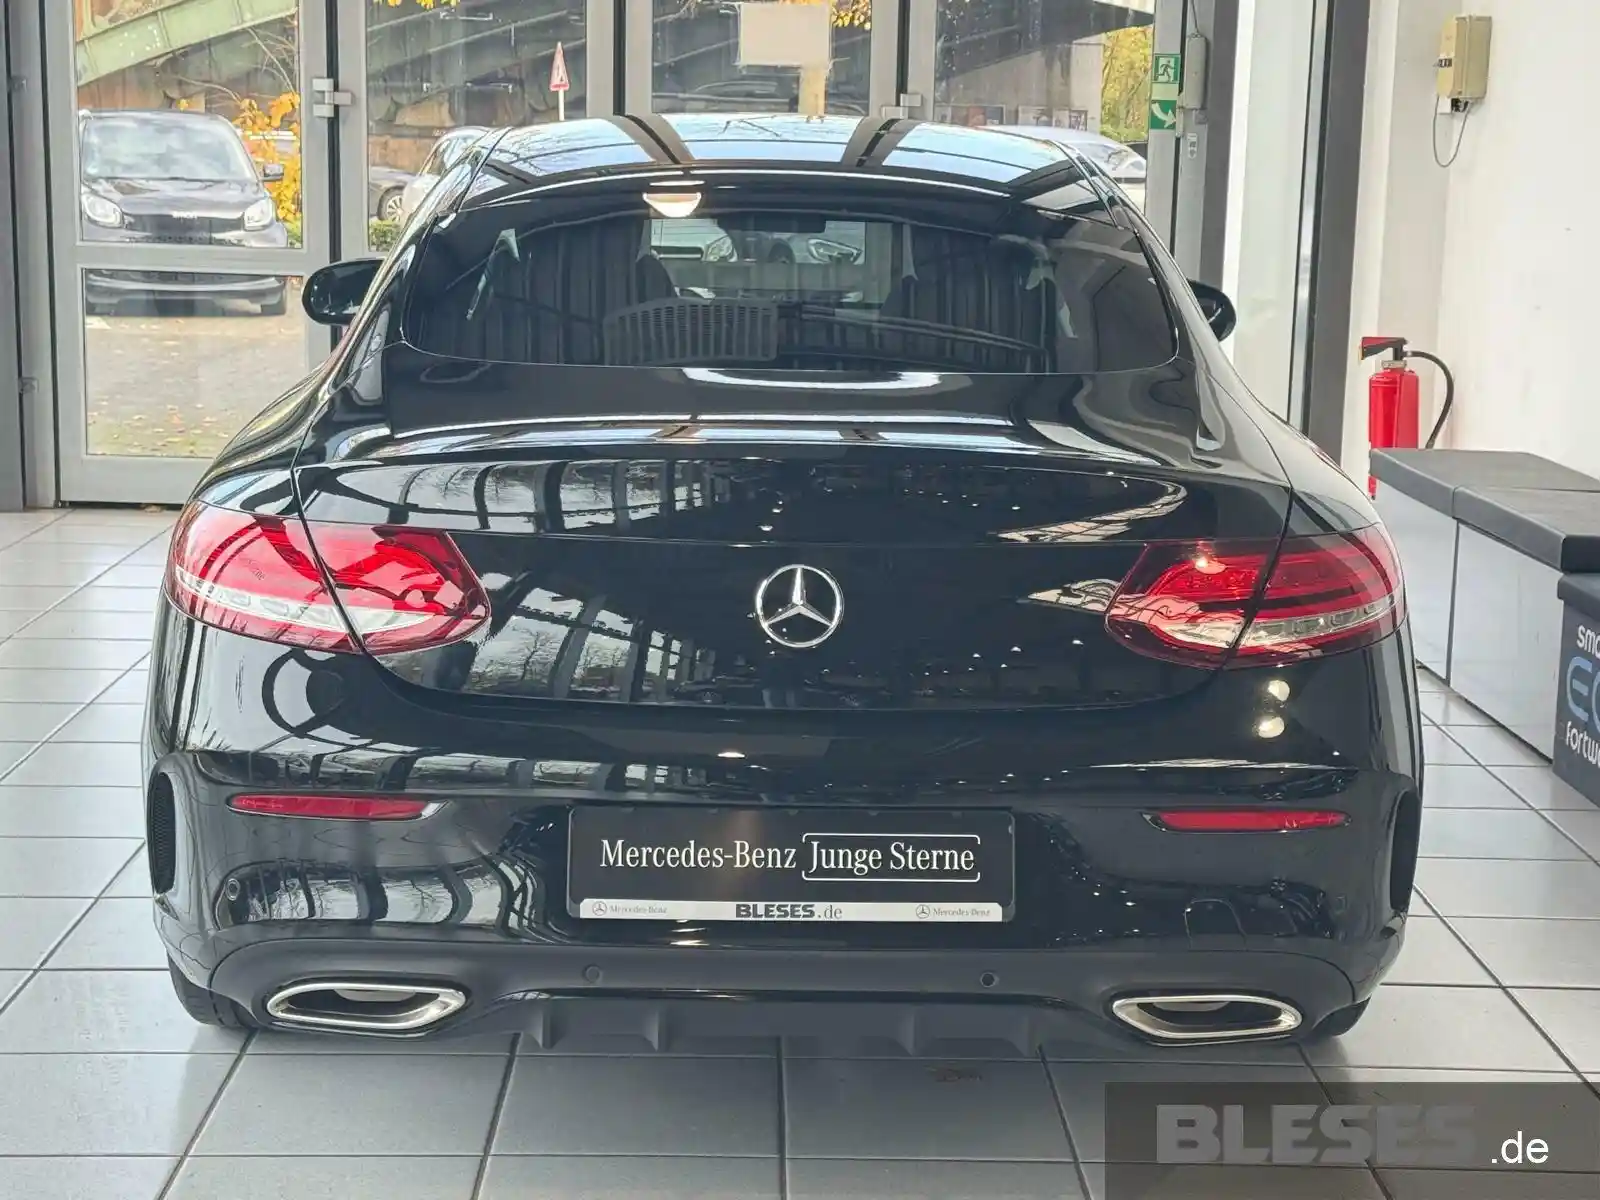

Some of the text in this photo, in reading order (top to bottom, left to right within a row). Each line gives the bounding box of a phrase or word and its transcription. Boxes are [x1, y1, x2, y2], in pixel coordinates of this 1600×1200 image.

[600, 838, 976, 876] Mercedes-Benz Junge Sterne
